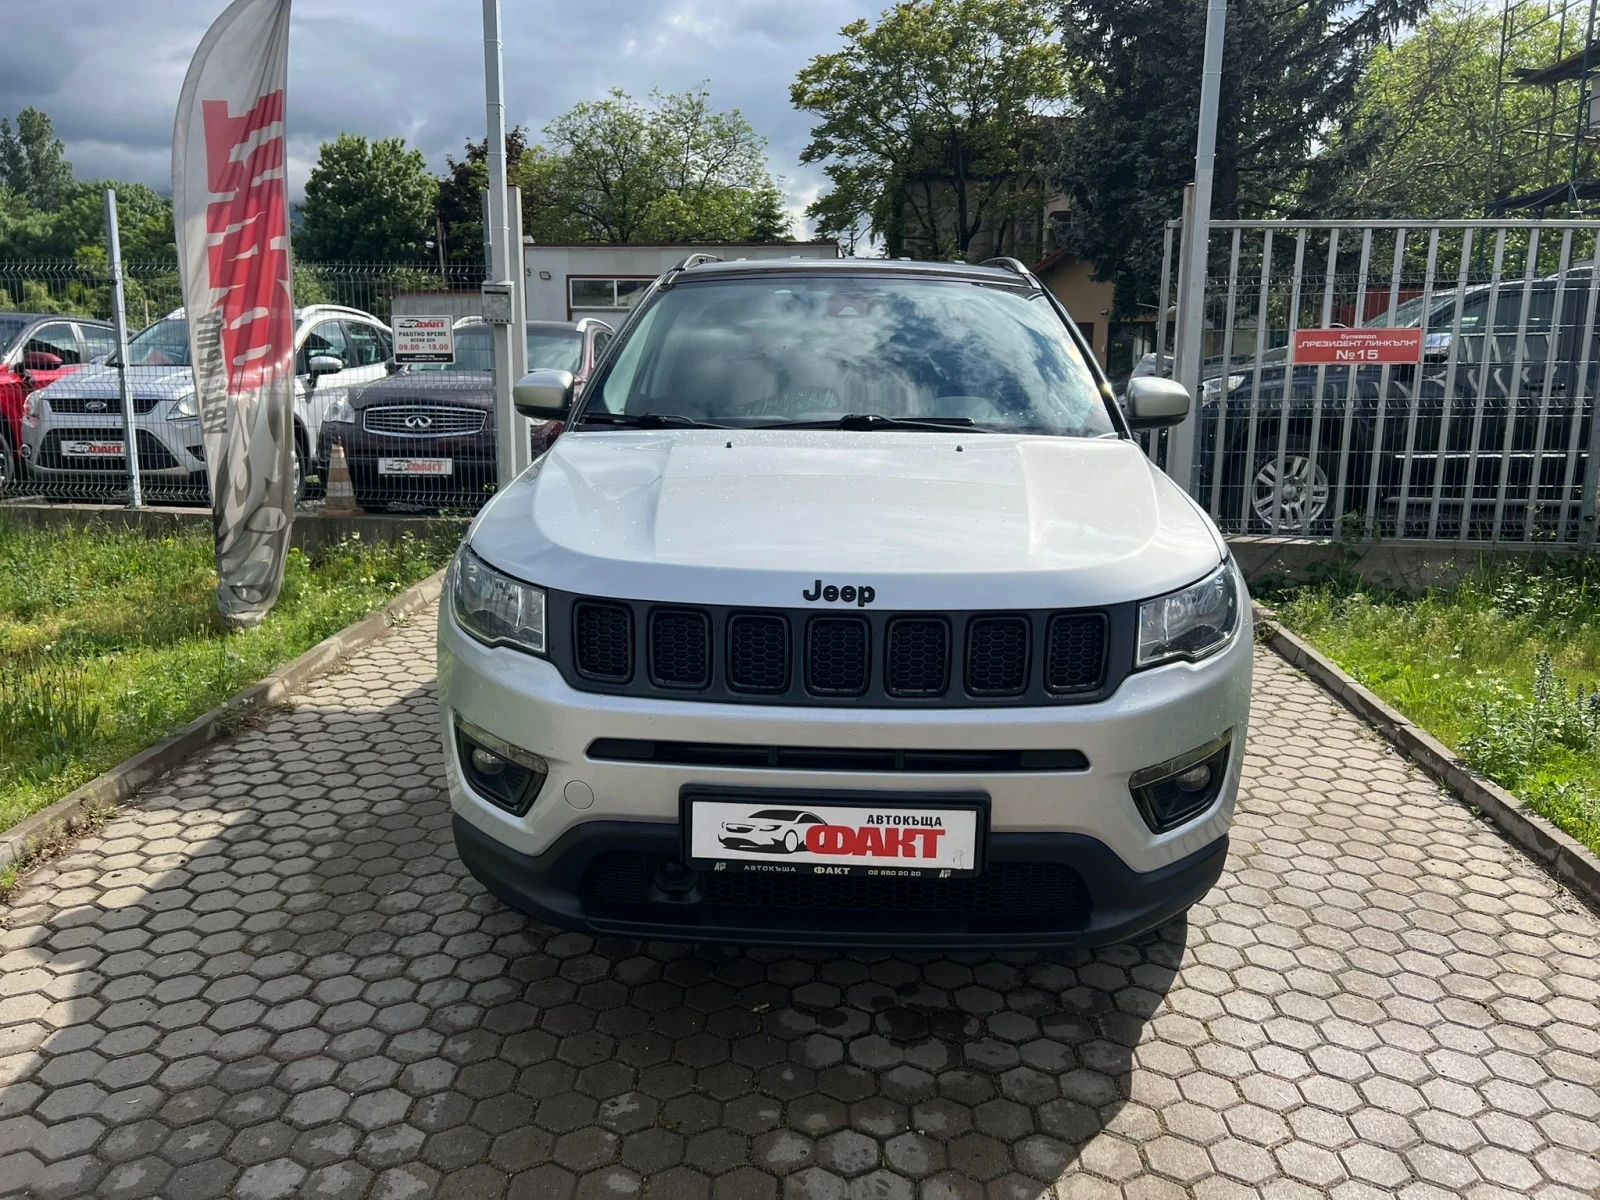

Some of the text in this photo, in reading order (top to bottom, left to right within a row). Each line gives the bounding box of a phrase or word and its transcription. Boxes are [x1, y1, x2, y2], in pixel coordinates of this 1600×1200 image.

[398, 343, 420, 351] 09.00
[428, 343, 449, 351] 18.00
[196, 309, 228, 435] АВТОКЪЩА
[802, 579, 876, 608] Jeep
[866, 814, 943, 829] АВТОКЪЩА
[805, 824, 946, 859] ФАКТ
[813, 865, 851, 875] ФАКТ
